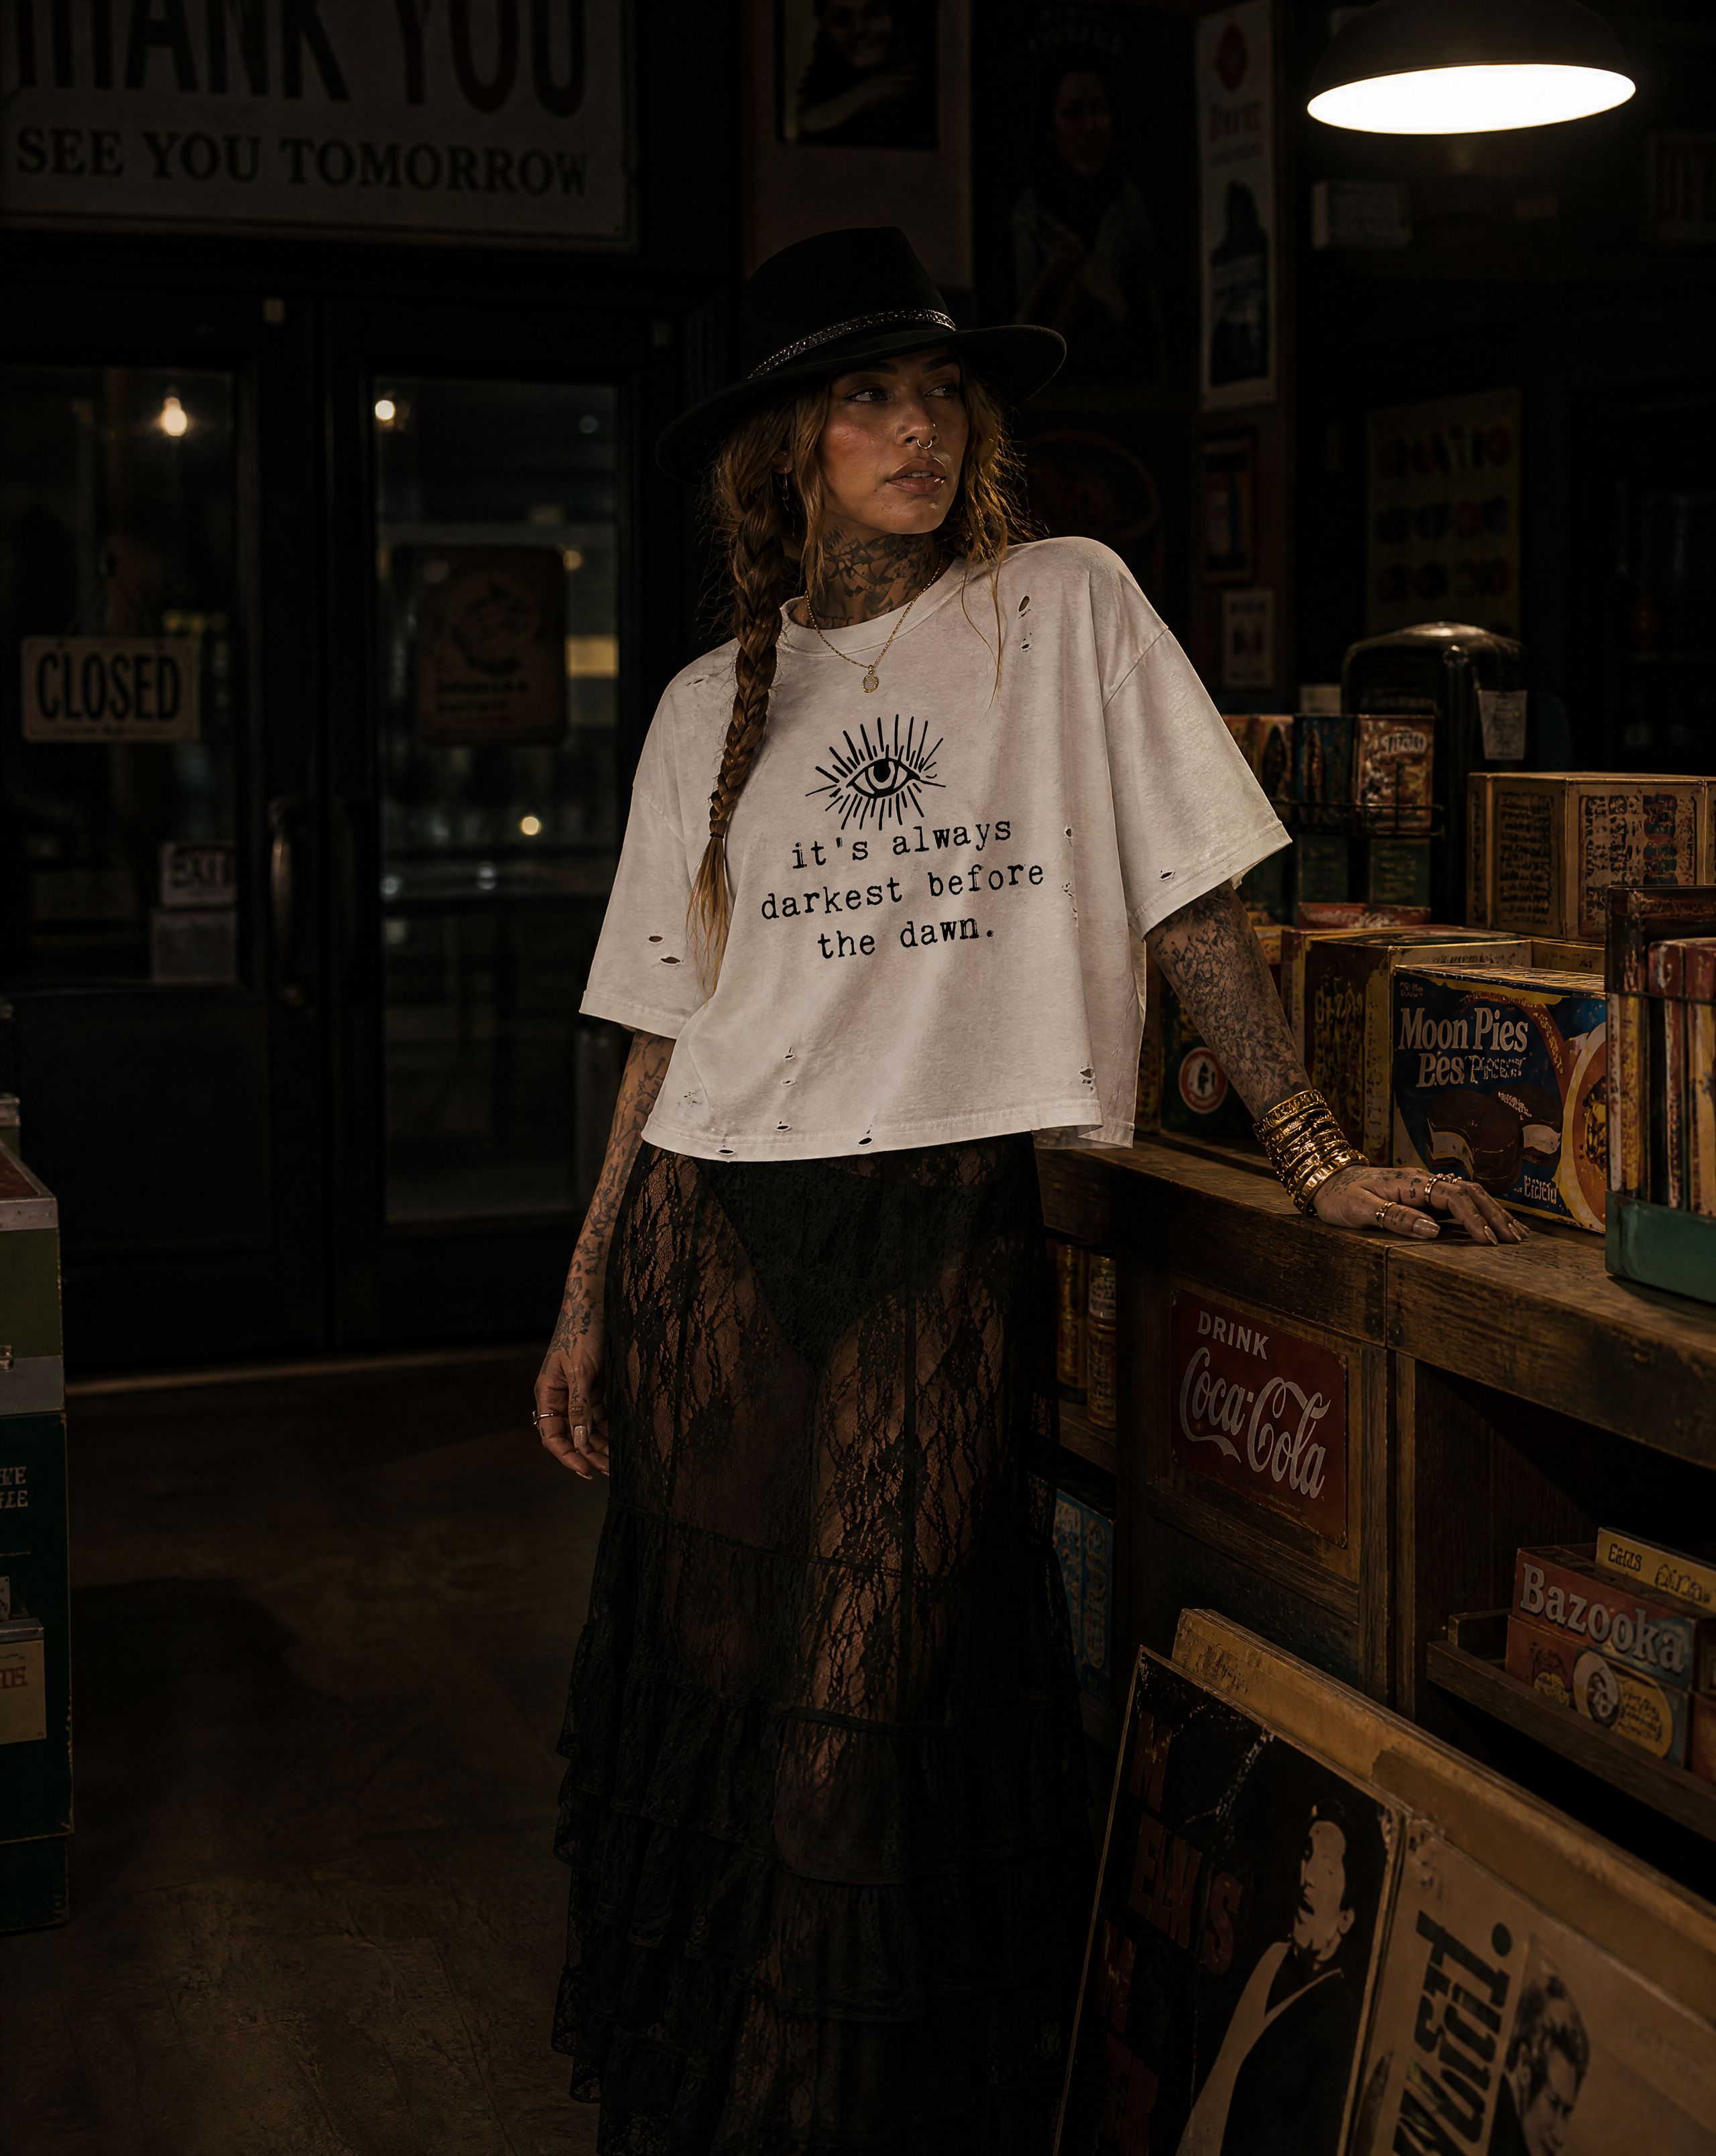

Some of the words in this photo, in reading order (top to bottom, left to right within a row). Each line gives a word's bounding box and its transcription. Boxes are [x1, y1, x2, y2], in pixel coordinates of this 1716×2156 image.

[17, 126, 125, 178] SEE
[141, 130, 262, 182] YOU
[280, 137, 587, 196] TOMORROW
[39, 654, 180, 720] CLOSED
[792, 837, 869, 869] it's
[892, 821, 1012, 855] always
[761, 877, 903, 920] darkest
[927, 864, 1044, 896] before
[817, 931, 875, 959] the
[900, 917, 994, 948] dawn.
[1397, 1007, 1469, 1051] Moon
[1472, 1006, 1529, 1053] Pies
[1197, 1309, 1270, 1361] DRINK
[1179, 1346, 1332, 1500] Coca-Cola
[1519, 1562, 1685, 1675] Bazooka
